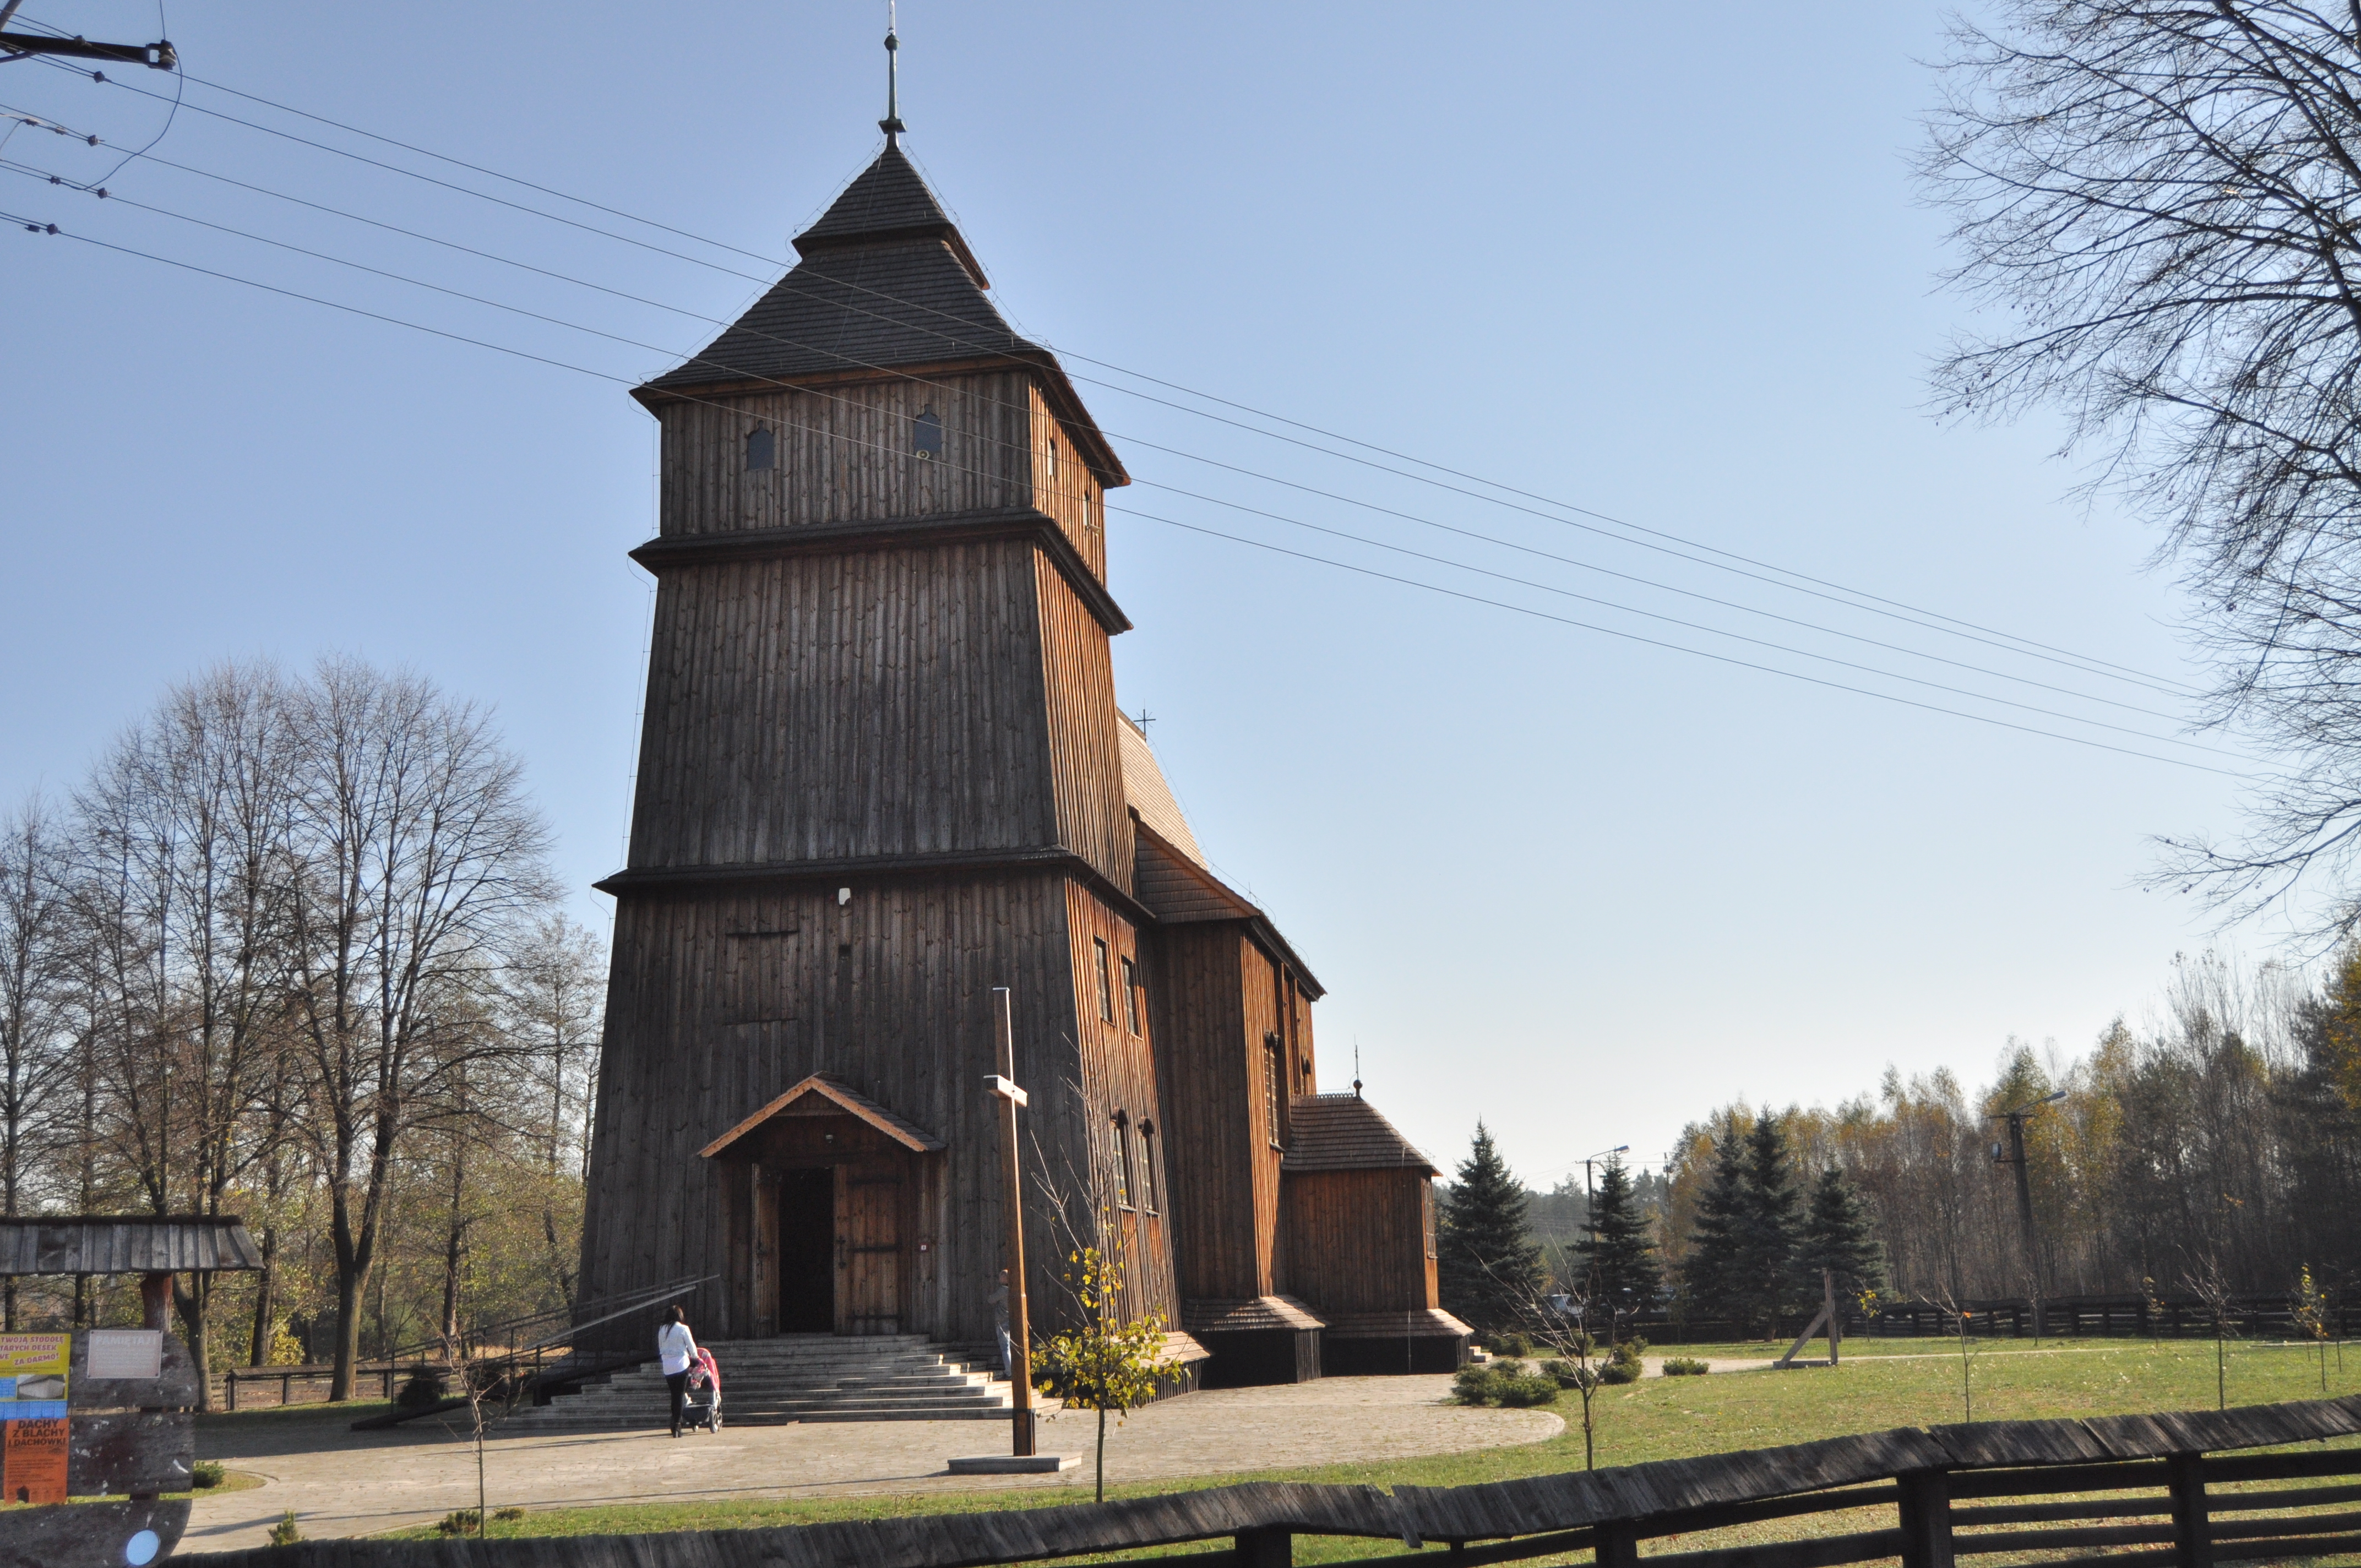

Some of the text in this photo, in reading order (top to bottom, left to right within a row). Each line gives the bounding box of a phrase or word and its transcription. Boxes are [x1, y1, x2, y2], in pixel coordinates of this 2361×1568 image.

[27, 1353, 59, 1363] DARMO!
[18, 1420, 59, 1429] DACHY
[23, 1428, 65, 1438] BLACHY
